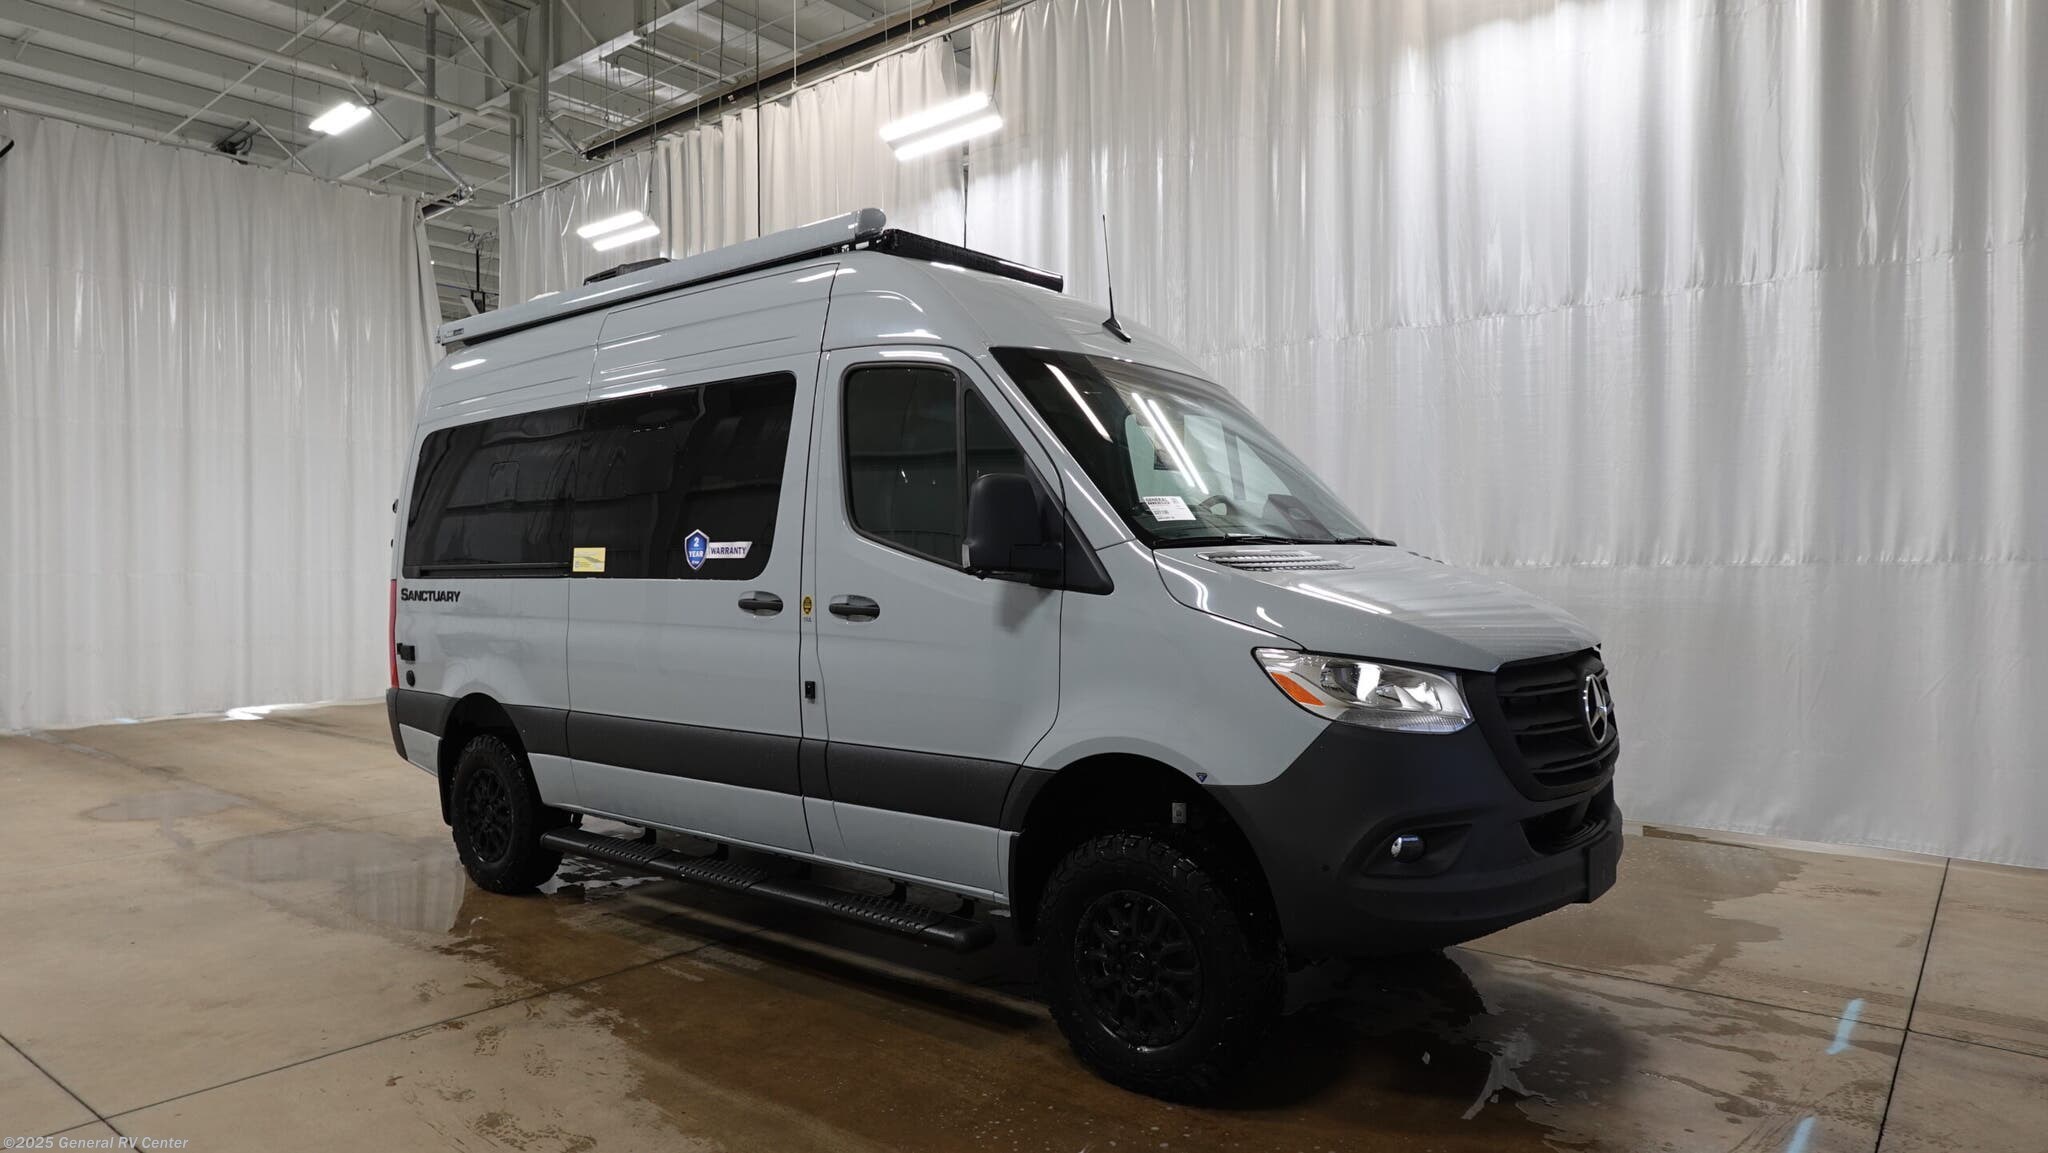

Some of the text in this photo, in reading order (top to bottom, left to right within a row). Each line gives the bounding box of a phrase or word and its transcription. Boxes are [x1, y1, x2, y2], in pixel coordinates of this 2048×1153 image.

[693, 536, 700, 547] 2
[688, 550, 704, 558] YEAR
[710, 546, 747, 555] WARRANTY
[401, 587, 461, 602] SANCTUARY
